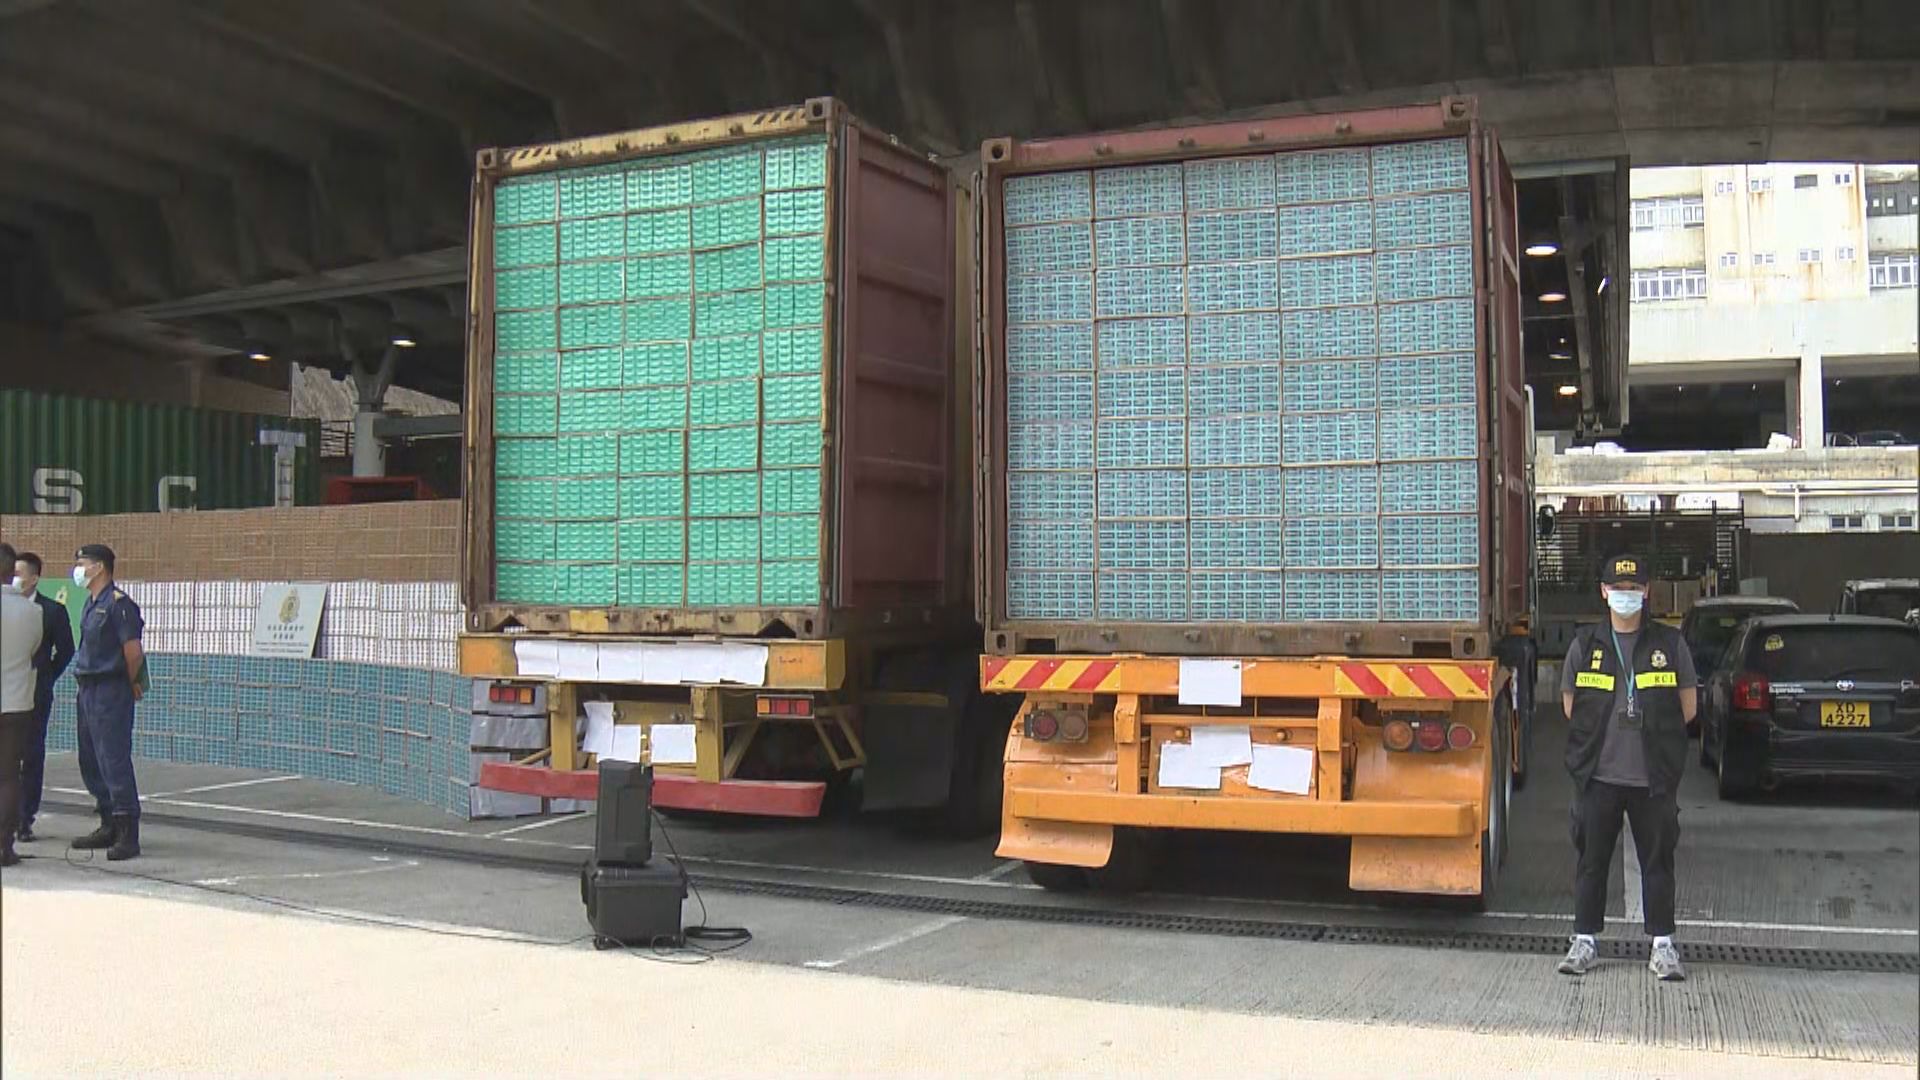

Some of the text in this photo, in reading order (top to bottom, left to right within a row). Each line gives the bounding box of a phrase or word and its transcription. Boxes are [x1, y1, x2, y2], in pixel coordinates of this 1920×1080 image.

[33, 468, 83, 513] S
[1835, 703, 1856, 714] XD
[1826, 714, 1867, 725] 4227
